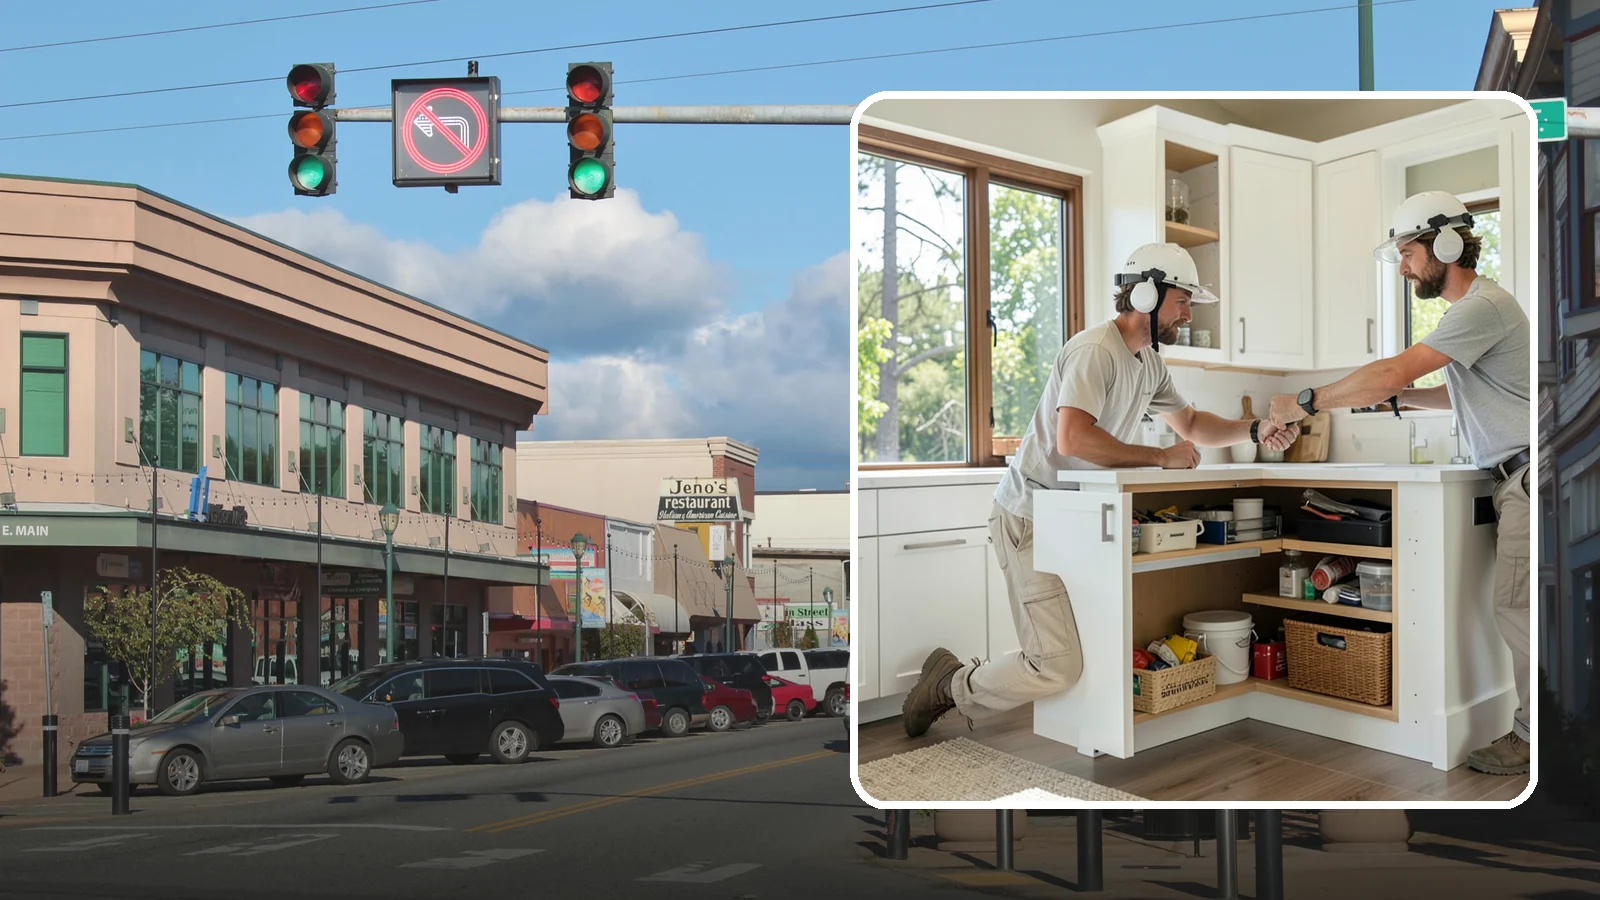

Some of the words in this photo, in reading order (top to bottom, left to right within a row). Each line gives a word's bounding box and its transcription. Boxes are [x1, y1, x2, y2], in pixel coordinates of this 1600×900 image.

[670, 480, 727, 494] Jeno's
[665, 496, 731, 509] restaurant
[659, 509, 681, 519] Italian
[686, 509, 714, 519] American
[715, 509, 737, 519] Cuisine
[2, 525, 13, 536] E.
[15, 525, 49, 536] MAIN
[797, 607, 828, 617] Street
[791, 619, 824, 627] lass
